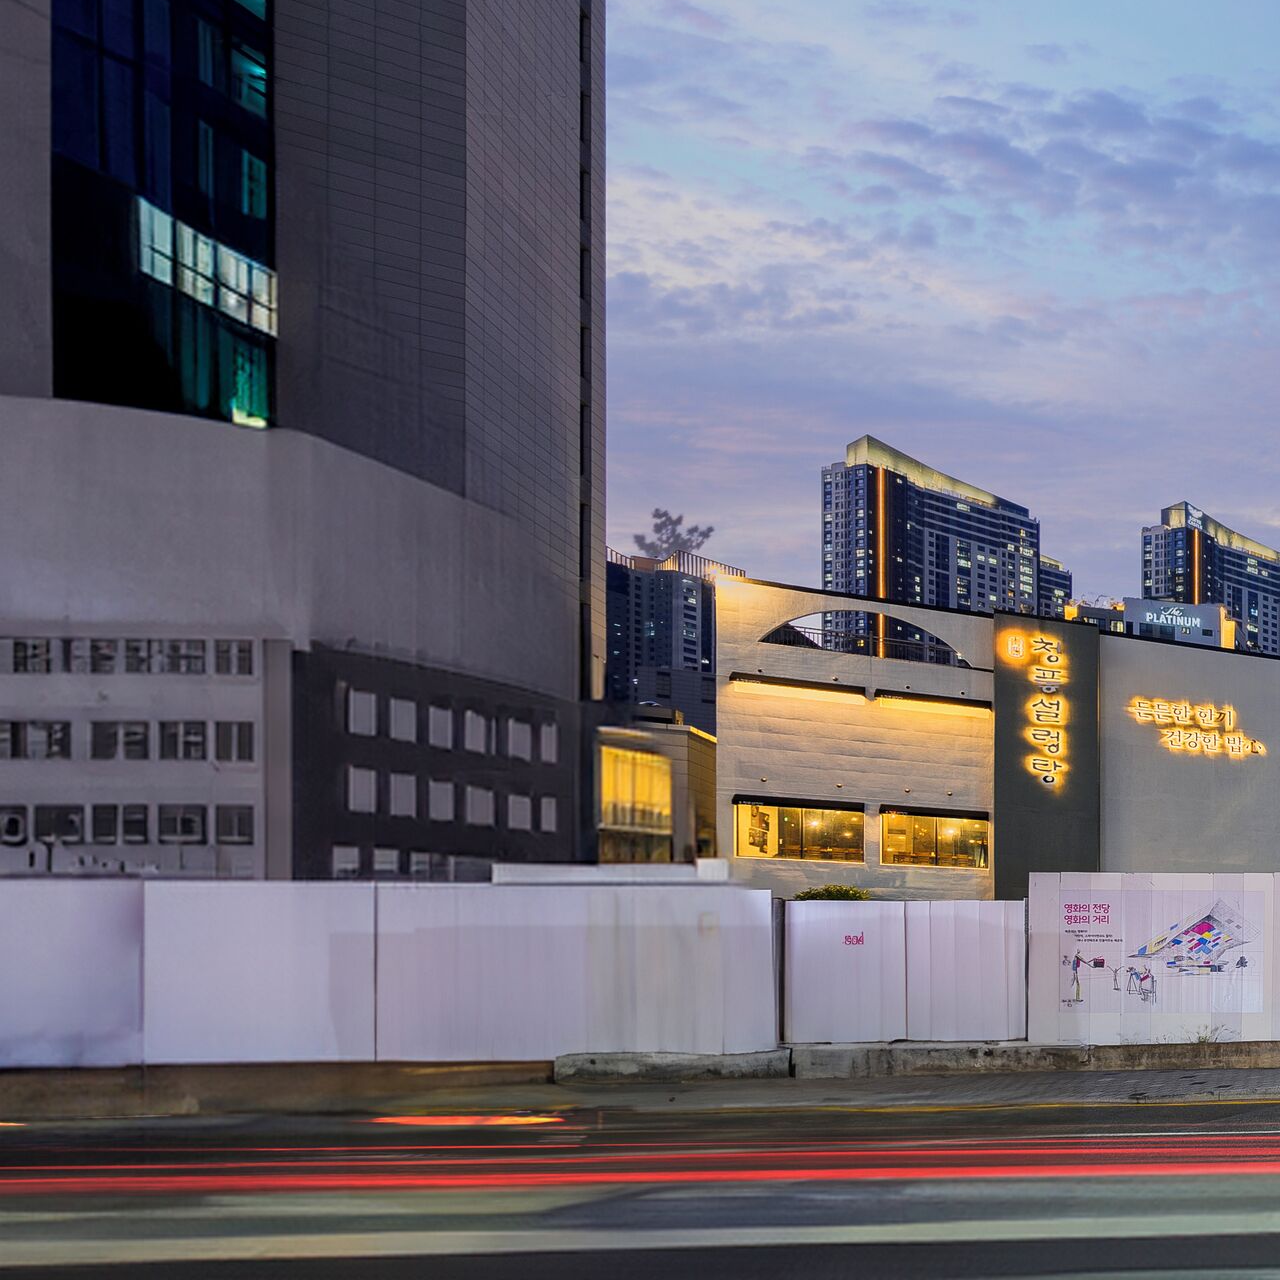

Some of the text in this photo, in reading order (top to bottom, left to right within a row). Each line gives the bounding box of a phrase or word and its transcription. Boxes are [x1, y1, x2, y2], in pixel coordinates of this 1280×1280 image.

[1161, 606, 1184, 616] The
[1146, 612, 1201, 628] PLATINUM
[1032, 636, 1063, 785] 청풍설렁탕
[1134, 700, 1232, 726] 든든한 한끼
[1166, 729, 1219, 752] 건강한
[1064, 903, 1111, 914] 영화의 전당
[1064, 915, 1110, 926] 영화의 거리
